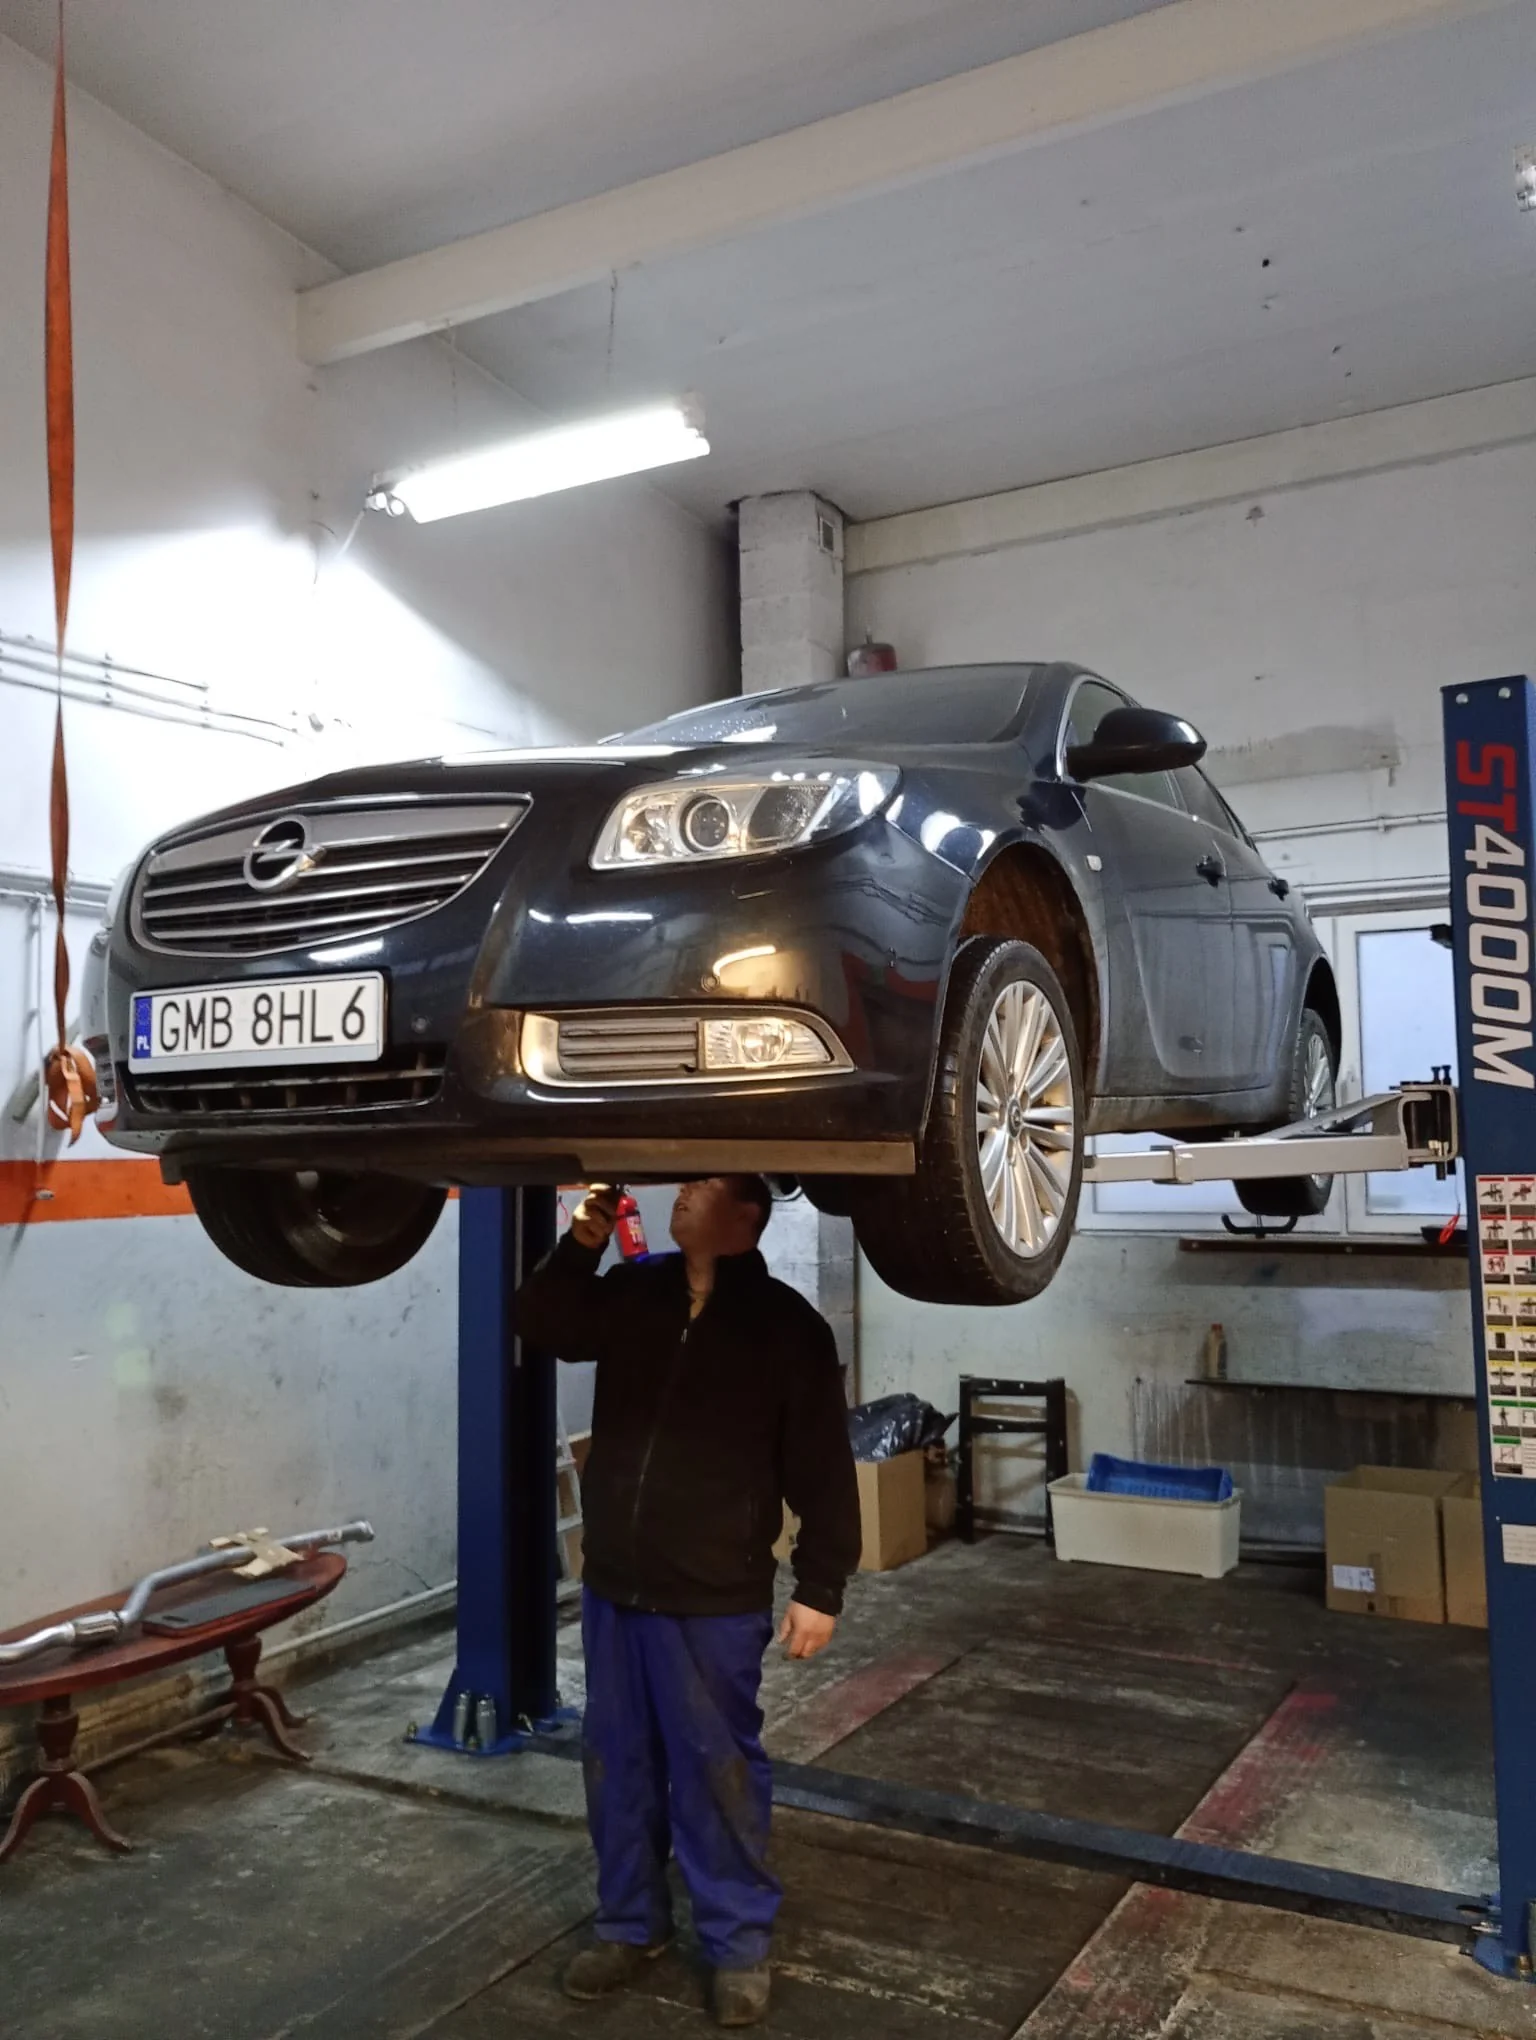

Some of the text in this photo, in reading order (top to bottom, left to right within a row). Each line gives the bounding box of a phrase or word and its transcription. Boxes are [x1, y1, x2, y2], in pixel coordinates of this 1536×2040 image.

[1456, 740, 1535, 1089] ST4000M
[136, 1035, 149, 1050] PL
[160, 986, 365, 1051] GMB 8HL6
